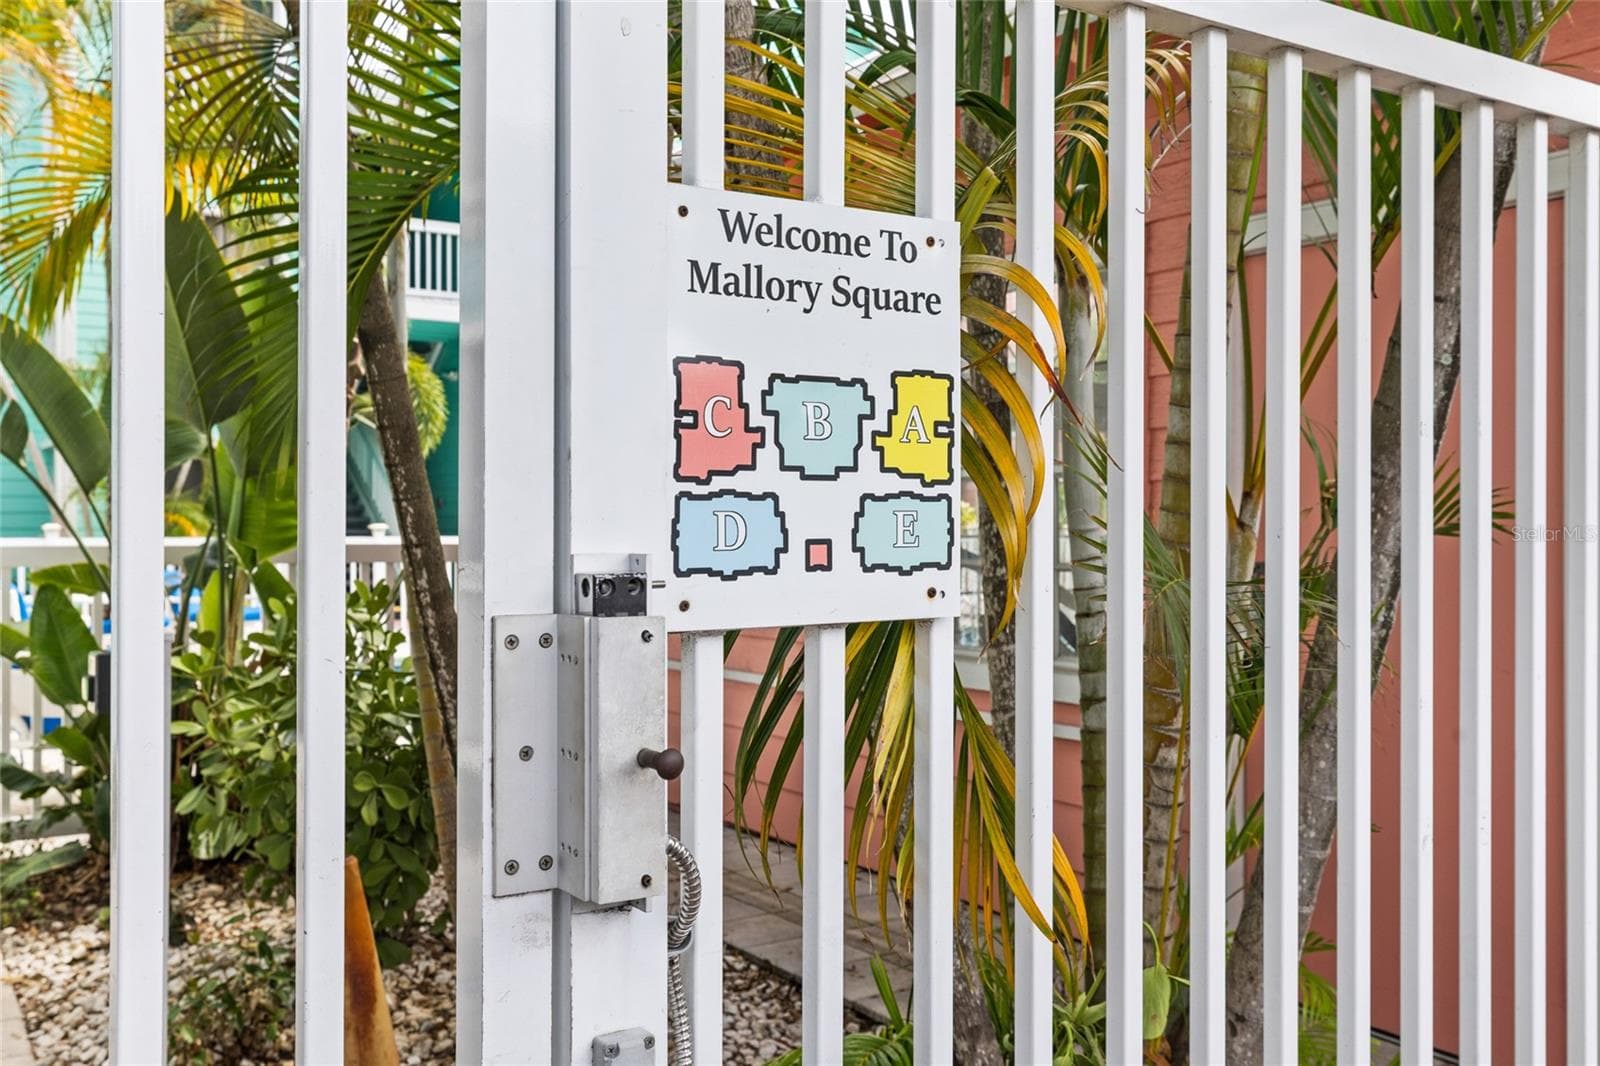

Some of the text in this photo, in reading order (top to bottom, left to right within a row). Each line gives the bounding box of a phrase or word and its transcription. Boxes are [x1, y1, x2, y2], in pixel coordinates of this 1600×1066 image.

[717, 208, 918, 263] Welcome To
[687, 259, 942, 319] Mallory Square
[703, 396, 931, 444] C B A
[713, 510, 920, 551] D E
